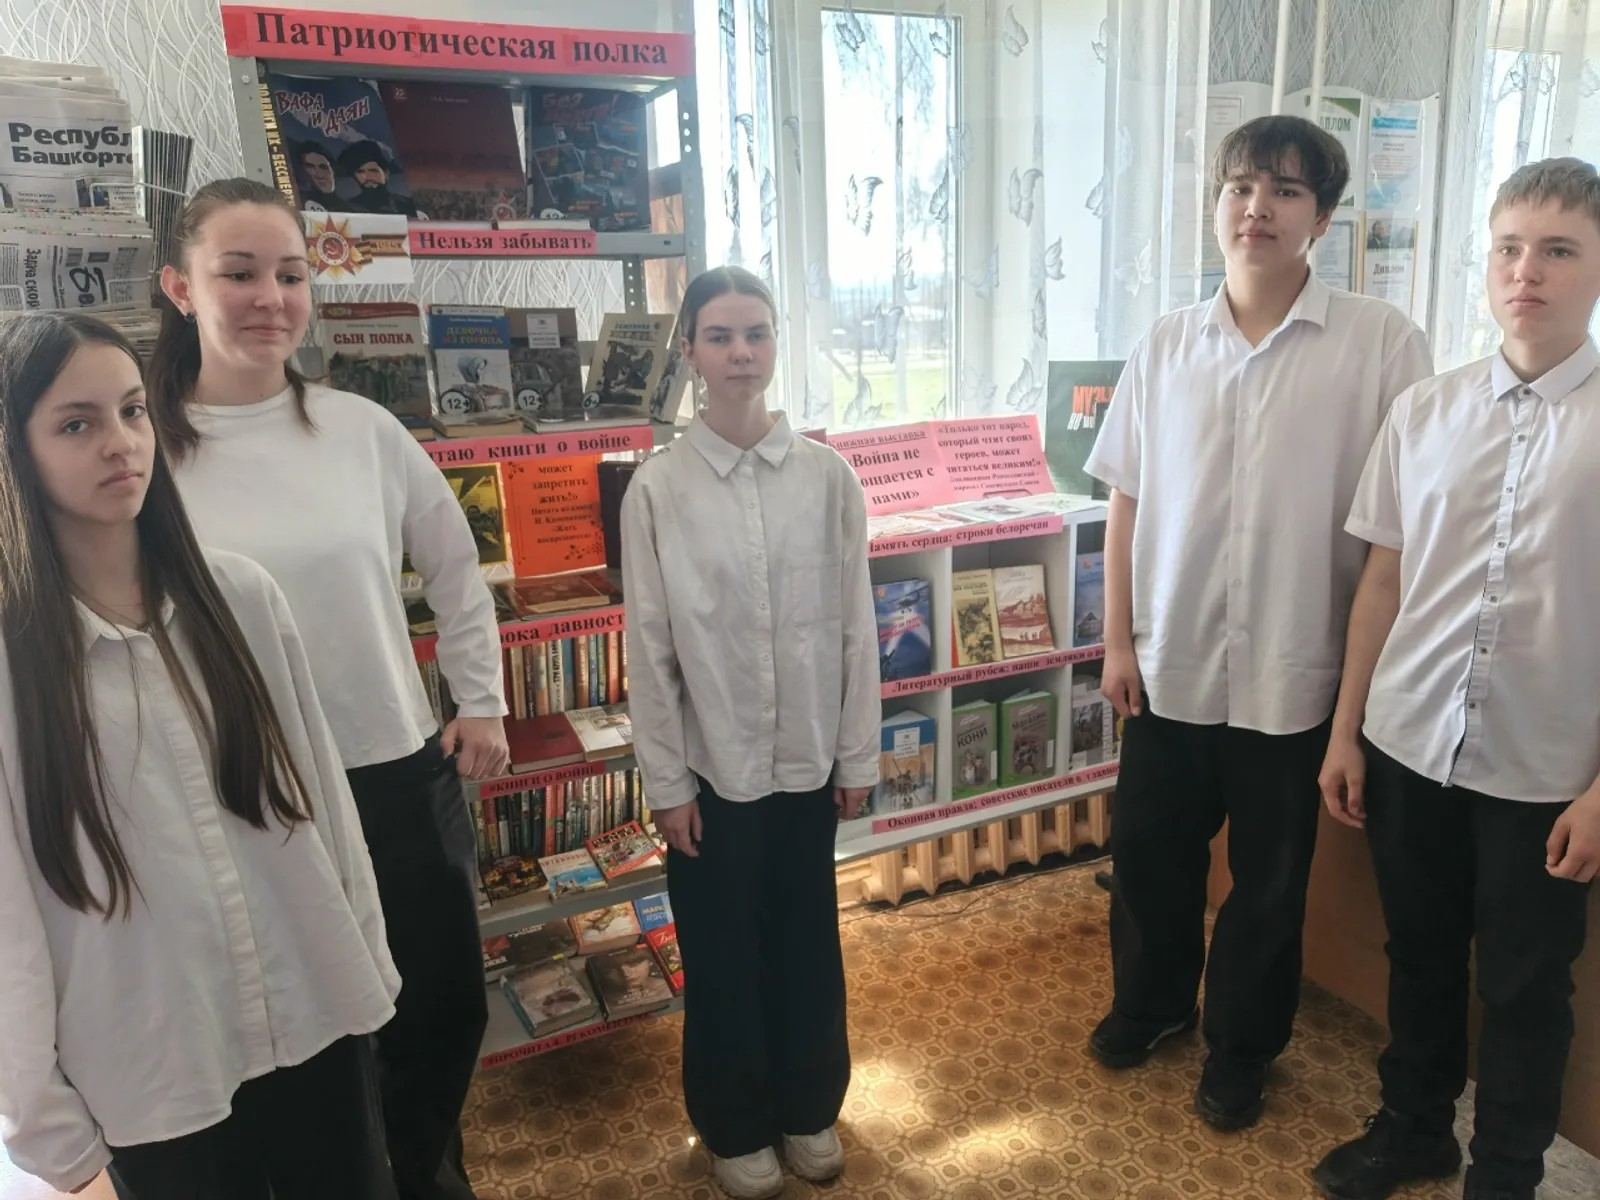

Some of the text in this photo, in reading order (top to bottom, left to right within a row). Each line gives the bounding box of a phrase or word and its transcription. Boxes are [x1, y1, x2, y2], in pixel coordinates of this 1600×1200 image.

[255, 12, 668, 64] Патриотическая полка
[419, 231, 493, 250] Нельзя
[499, 232, 592, 250] забывать
[333, 333, 414, 345] СЫН ПОЛКА
[447, 398, 470, 410] 12+
[878, 431, 927, 444] выставка
[937, 433, 1034, 448] который чтит своих
[488, 441, 546, 459] книги
[557, 441, 568, 452] о
[578, 434, 631, 450] войне
[904, 448, 920, 460] не
[991, 448, 1021, 457] может
[538, 465, 573, 475] может
[860, 466, 935, 488] ощается с
[533, 478, 588, 490] запретить
[871, 490, 920, 505] нами»
[956, 528, 994, 542] строки
[995, 519, 1048, 535] белоречан
[893, 672, 972, 692] Литературный
[975, 666, 1009, 681] рубеж:
[1012, 659, 1039, 672] наши
[1046, 653, 1085, 665] земляки
[956, 728, 988, 748] КОНИ
[981, 789, 1028, 806] советские
